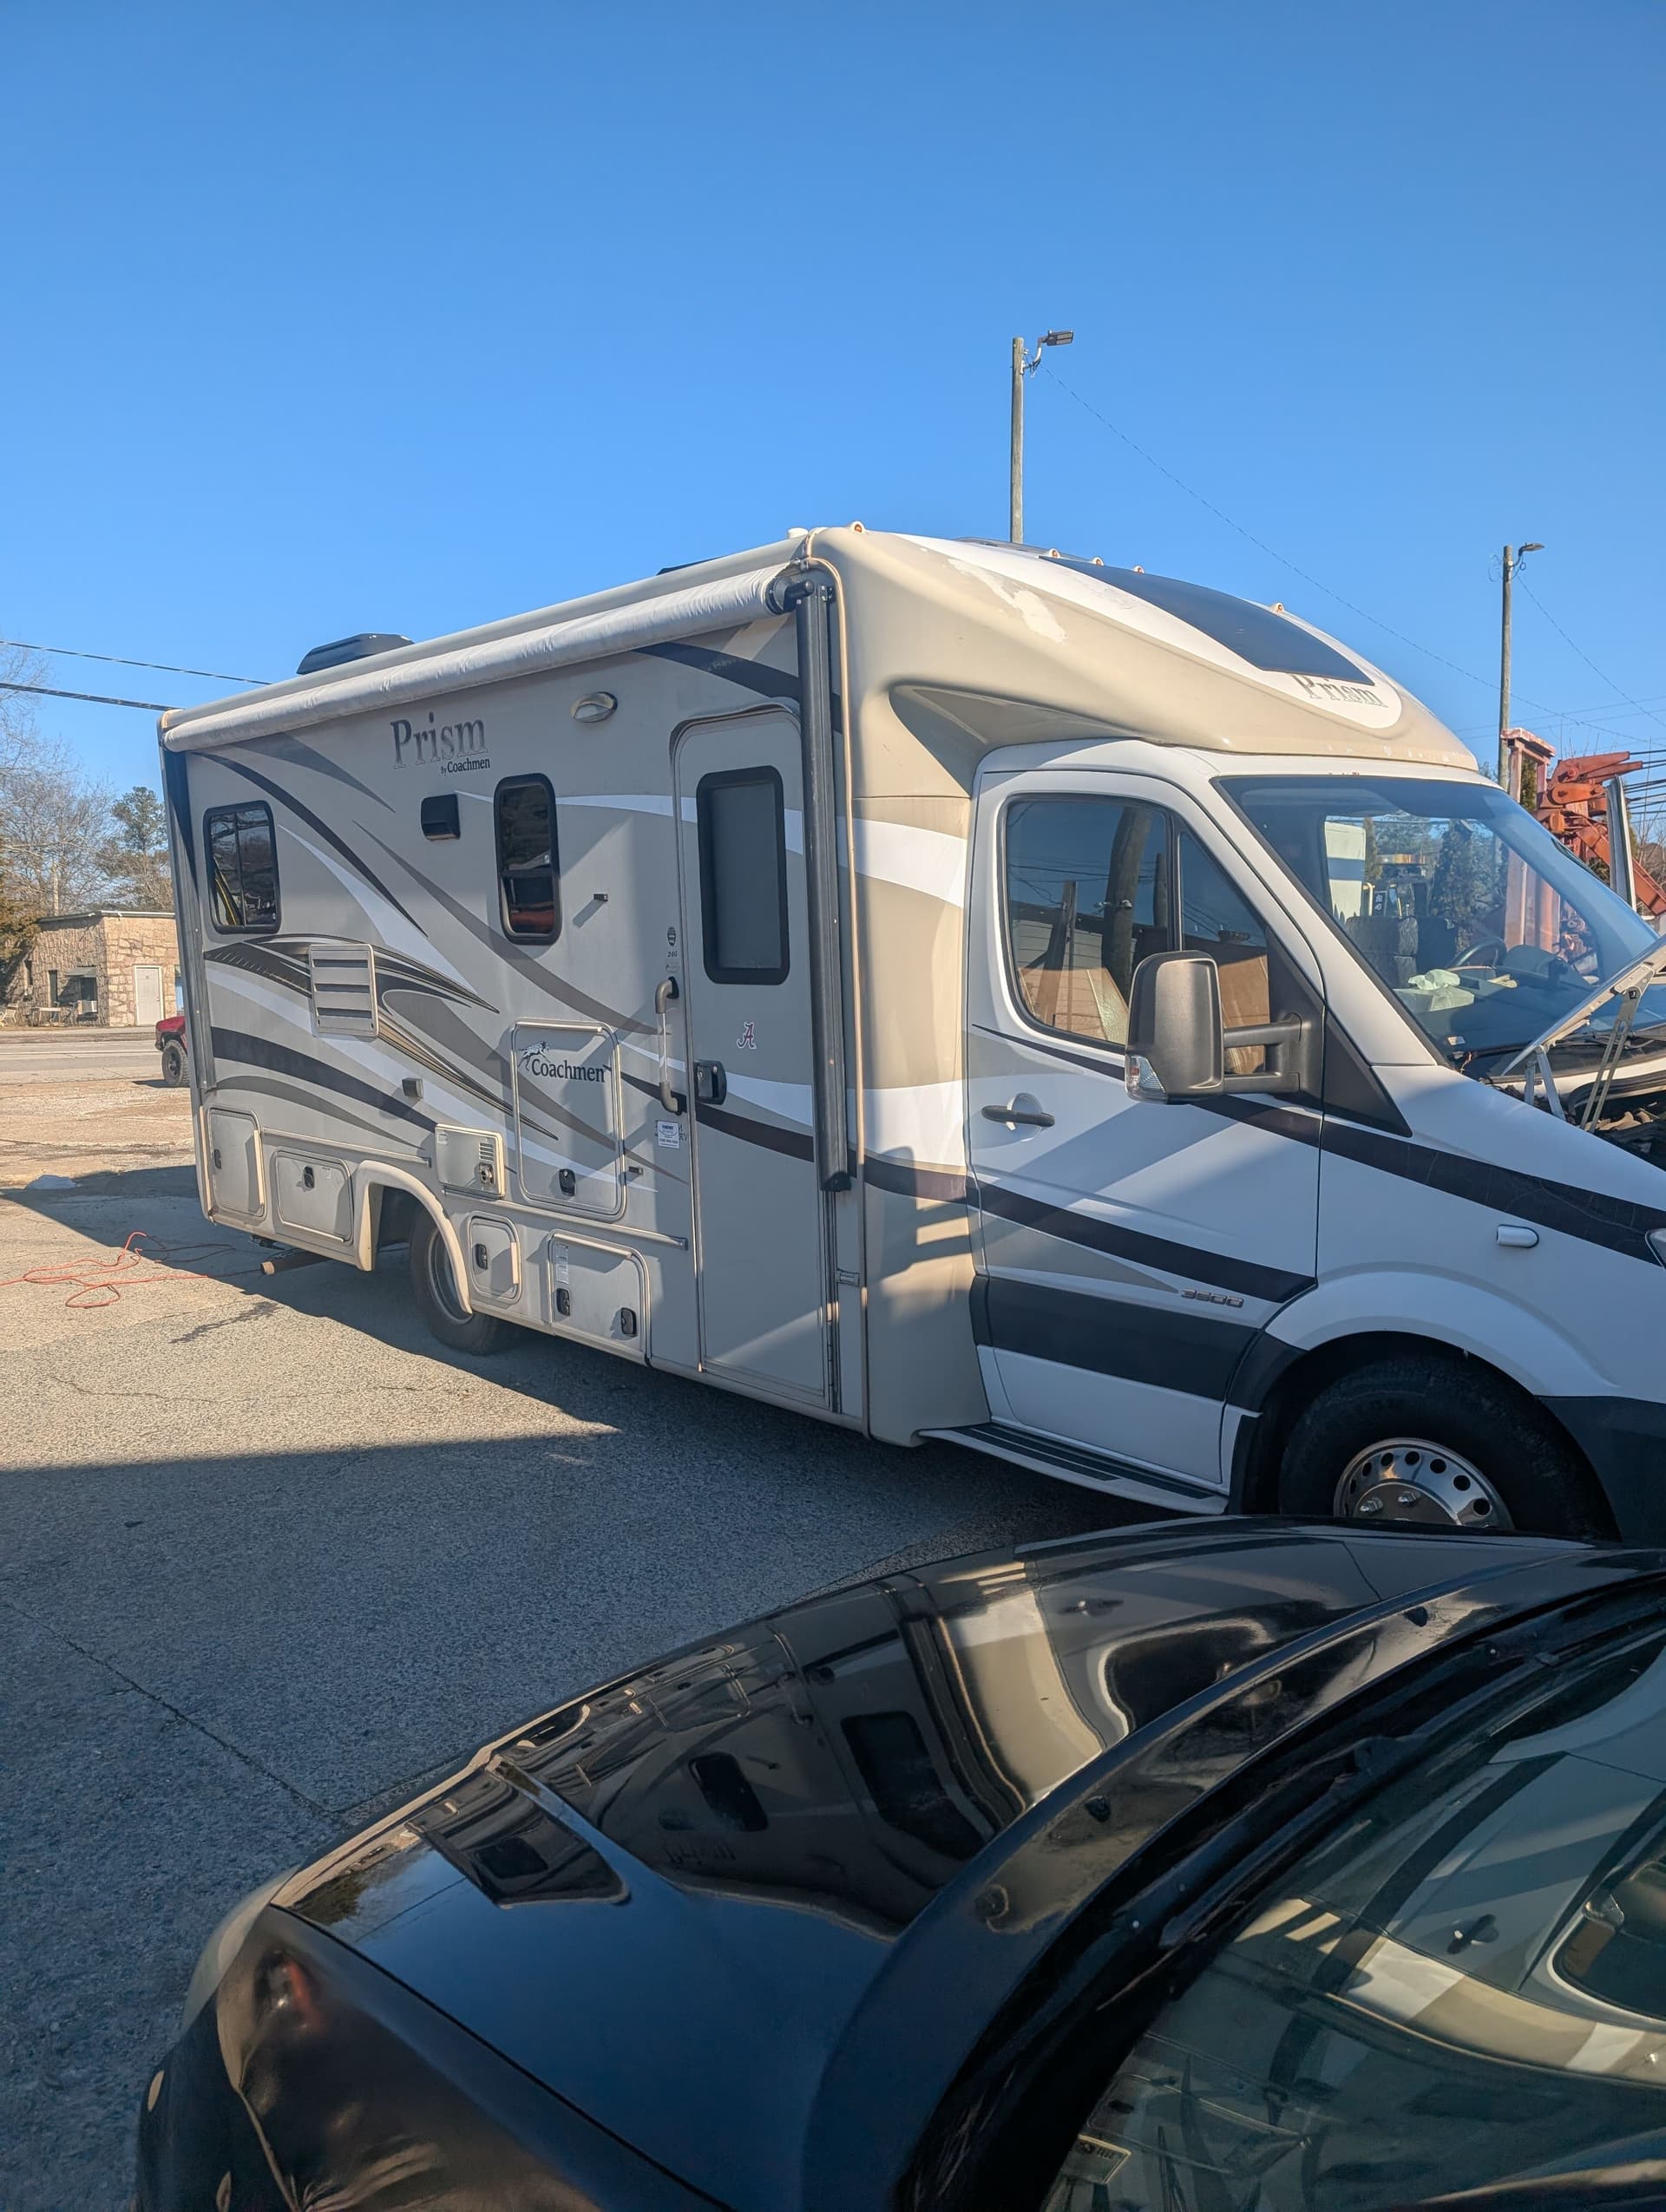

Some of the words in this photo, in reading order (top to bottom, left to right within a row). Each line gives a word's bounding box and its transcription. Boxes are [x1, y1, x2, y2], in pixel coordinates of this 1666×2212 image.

[1290, 674, 1388, 708] Prism
[390, 712, 488, 769] Prism
[447, 758, 491, 773] Coachmen
[737, 1021, 757, 1050] A
[531, 1058, 606, 1083] Coachmen
